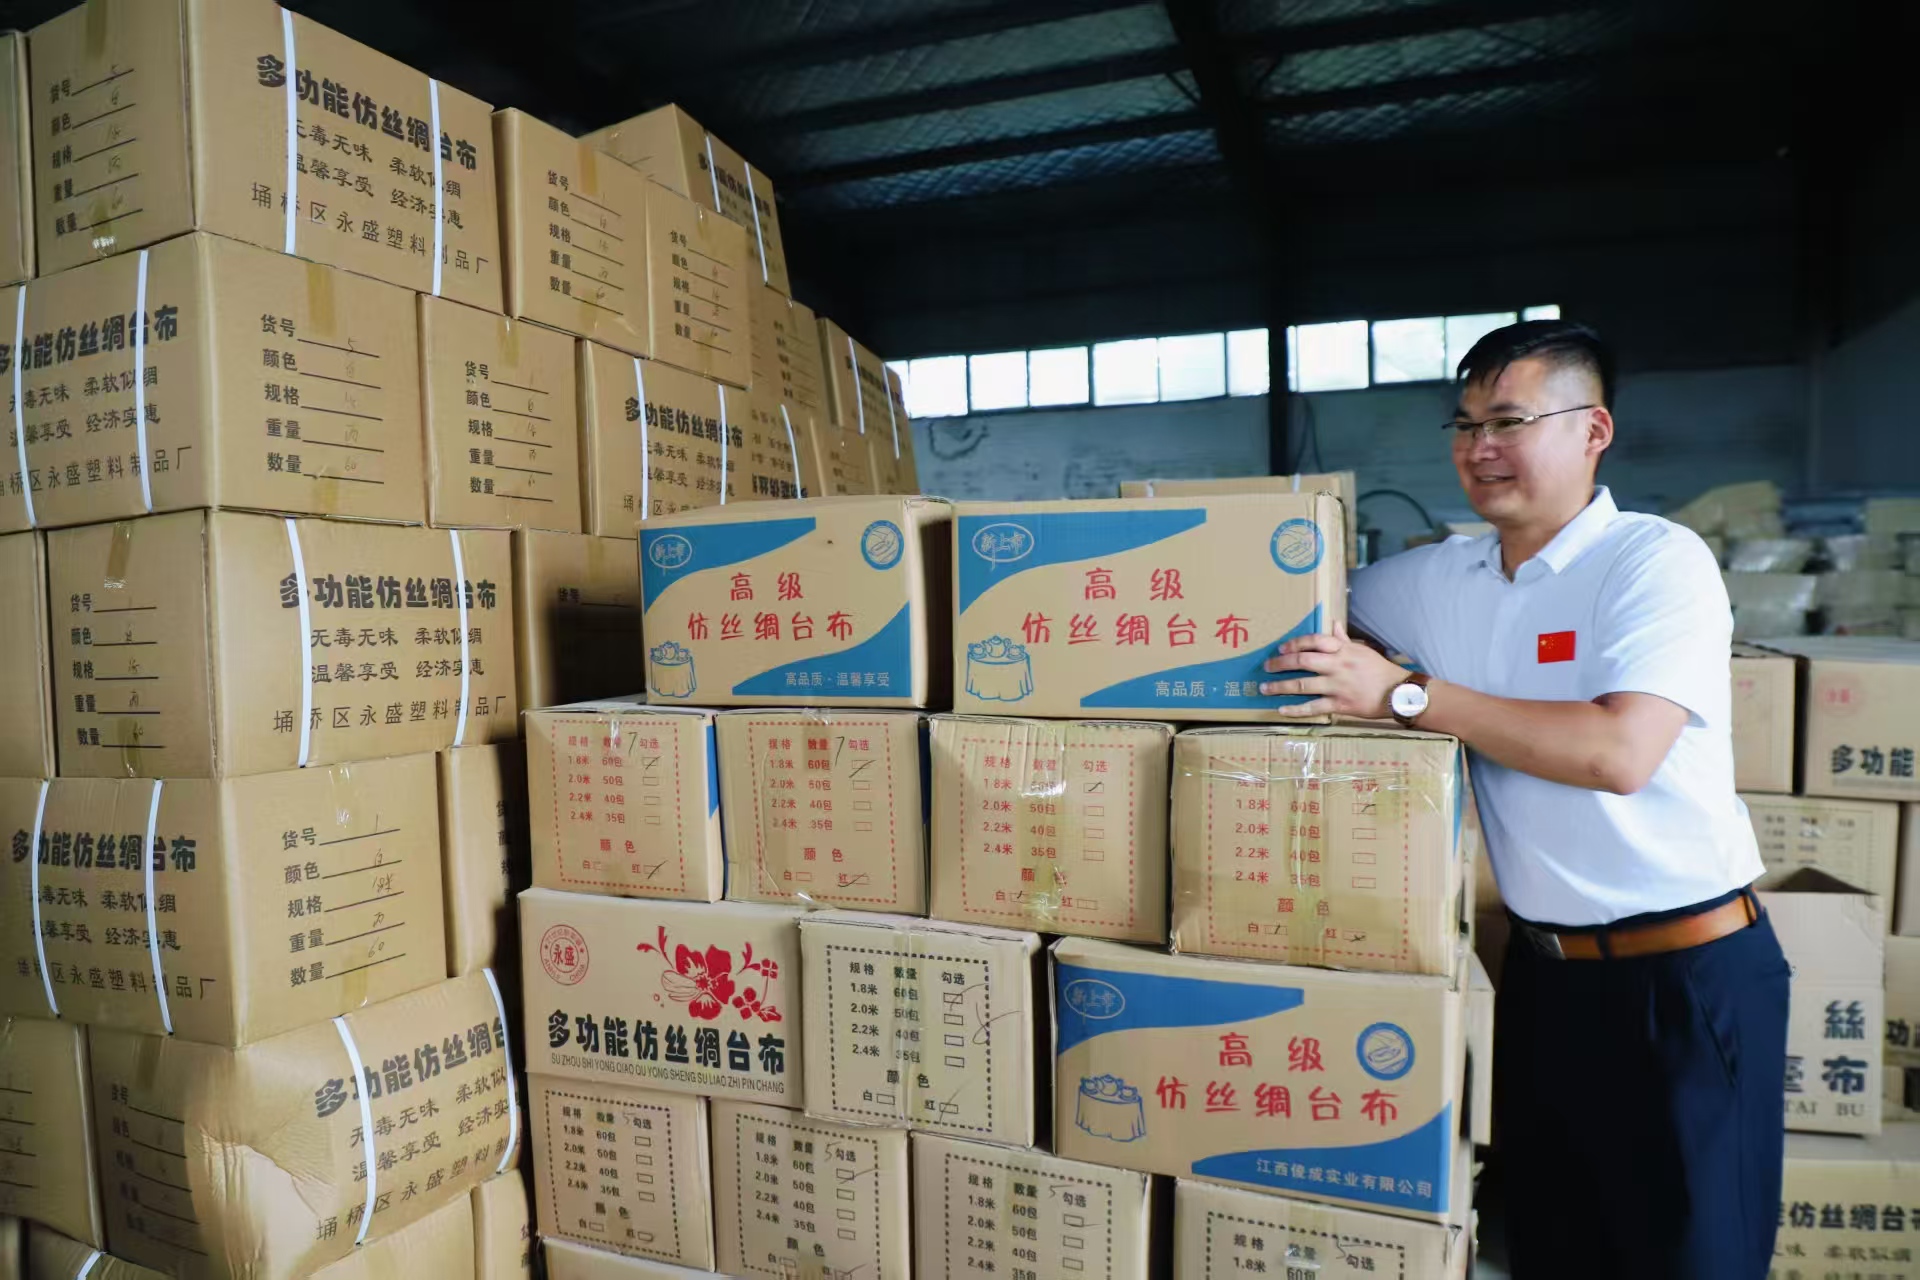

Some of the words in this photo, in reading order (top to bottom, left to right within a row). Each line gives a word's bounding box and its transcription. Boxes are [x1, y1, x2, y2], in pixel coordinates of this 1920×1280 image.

[547, 170, 569, 192] 货号
[549, 223, 571, 244] 规格
[550, 250, 572, 270] 重量
[550, 276, 572, 297] 数量
[261, 313, 296, 338] 货号
[262, 348, 298, 372] 颜色
[465, 361, 489, 381] 货号
[264, 383, 300, 406] 规格
[466, 390, 492, 409] 颜色
[266, 418, 301, 440] 重量
[468, 418, 493, 437] 规格
[267, 452, 302, 474] 数量
[468, 448, 494, 466] 重量
[470, 476, 495, 495] 数量
[730, 572, 804, 600] 高级
[1084, 568, 1185, 601] 高级
[71, 593, 92, 613] 货号
[688, 611, 853, 641] 仿丝绸台布
[1021, 612, 1250, 649] 仿丝绸台布
[311, 628, 399, 649] 无毒无味
[72, 660, 94, 680] 规格
[311, 663, 400, 684] 温馨享受
[74, 694, 97, 713] 重量
[77, 728, 100, 746] 数量
[1083, 760, 1109, 773] 勾选
[1832, 744, 1914, 777] 多功能
[982, 801, 1012, 813] 2.0米
[282, 827, 317, 851] 货号
[983, 822, 1012, 834] 2.2米
[1235, 823, 1269, 836] 2.0米
[983, 843, 1013, 855] 2.4米
[1235, 846, 1269, 859] 2.2米
[284, 861, 320, 885] 颜色
[1235, 870, 1269, 884] 2.4米
[287, 895, 323, 919] 规格
[1278, 898, 1330, 915] 颜色
[289, 929, 324, 953] 重量
[290, 962, 325, 987] 数量
[850, 962, 875, 976] 规格
[941, 971, 965, 986] 勾选
[850, 982, 878, 995] 1.8米
[850, 1003, 879, 1016] 2.0米
[851, 1023, 880, 1037] 2.2米
[548, 1009, 785, 1075] 多功能仿丝绸台布
[852, 1044, 880, 1058] 2.4米
[1219, 1032, 1326, 1072] 高级
[562, 1055, 580, 1067] ZHOU
[582, 1057, 594, 1069] SHI
[594, 1059, 615, 1072] YONG
[647, 1066, 669, 1080] YONG
[670, 1068, 696, 1083] SHENG
[697, 1072, 708, 1084] SU
[709, 1073, 727, 1087] LIAO
[728, 1076, 741, 1088] ZHI
[742, 1077, 755, 1090] PIN
[756, 1080, 785, 1094] CHANG
[1821, 1056, 1868, 1094] 布
[1155, 1076, 1400, 1126] 仿丝绸台布
[756, 1151, 779, 1166] 1.8米
[793, 1160, 815, 1175] 60包
[755, 1171, 779, 1186] 2.0米
[793, 1180, 815, 1194] 50包
[968, 1173, 993, 1188] 规格
[1014, 1182, 1038, 1198] 数量
[1063, 1192, 1087, 1208] 勾选
[755, 1191, 779, 1205] 2.2米
[793, 1200, 815, 1214] 40包
[968, 1195, 995, 1210] 1.8米
[1012, 1204, 1038, 1220] 60包
[756, 1210, 780, 1225] 2.4米
[794, 1220, 816, 1233] 35包
[1778, 1201, 1920, 1232] 仿丝绸台
[968, 1216, 995, 1231] 2.0米
[1012, 1225, 1037, 1241] 50包
[968, 1236, 995, 1251] 2.2米
[1012, 1247, 1037, 1262] 40包
[1233, 1233, 1264, 1251] 规格
[1346, 1254, 1375, 1272] 勾选
[968, 1257, 995, 1272] 2.4米
[1233, 1257, 1267, 1273] 1.8米
